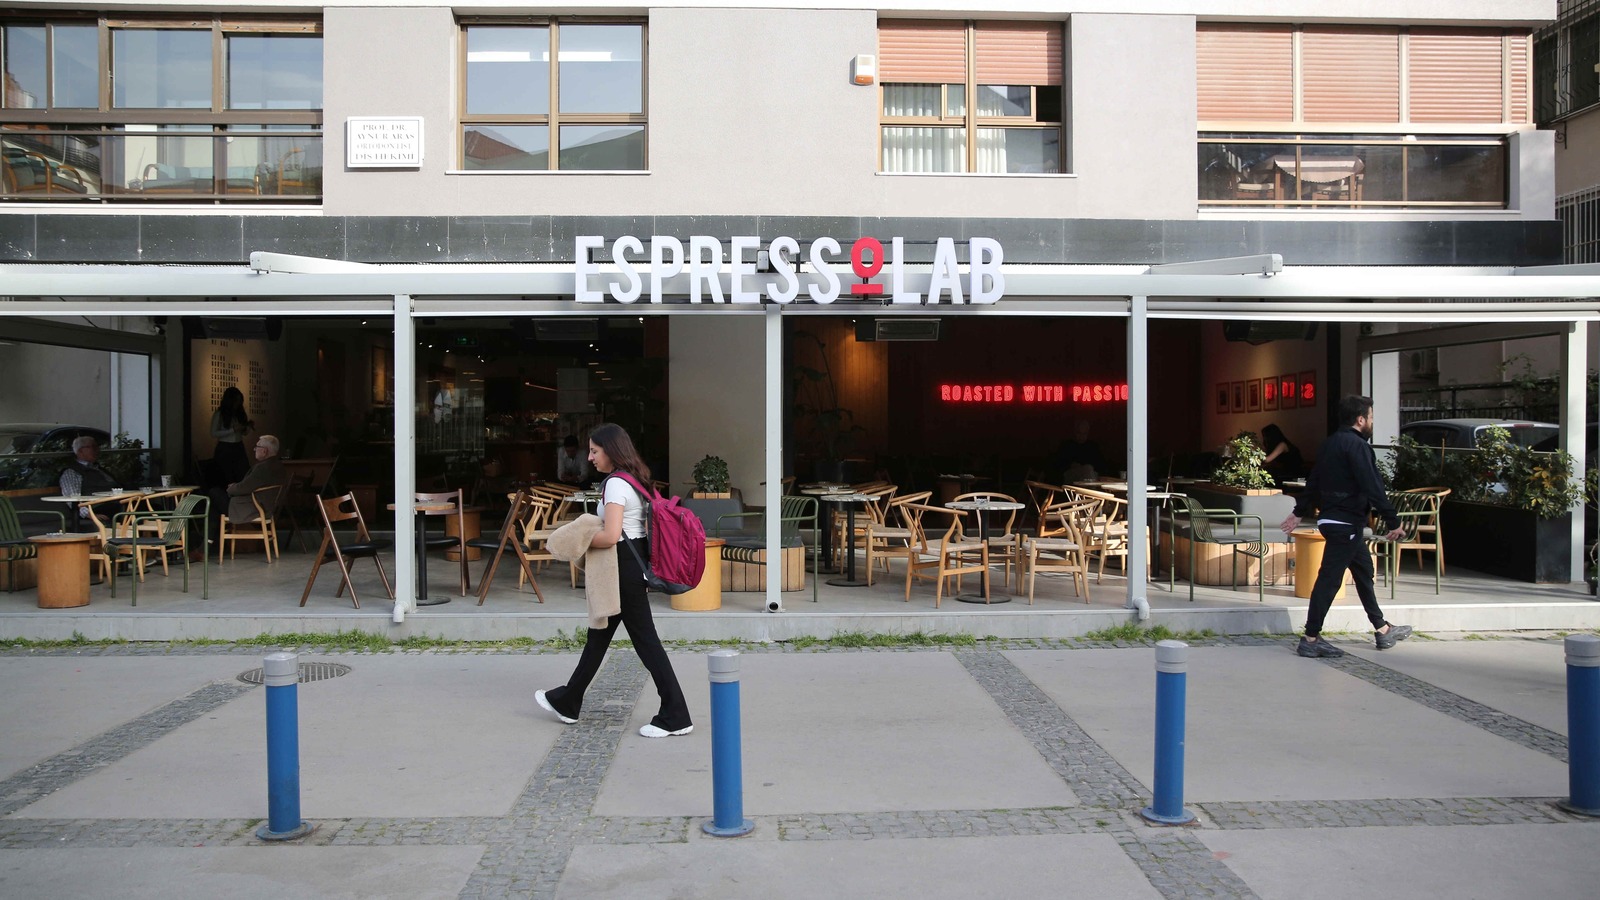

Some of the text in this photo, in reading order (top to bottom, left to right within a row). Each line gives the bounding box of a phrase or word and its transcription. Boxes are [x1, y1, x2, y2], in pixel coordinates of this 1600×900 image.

[575, 236, 1005, 305] ESPRESSOLAB
[941, 384, 1014, 402] ROASTED
[1023, 385, 1063, 402] WITH
